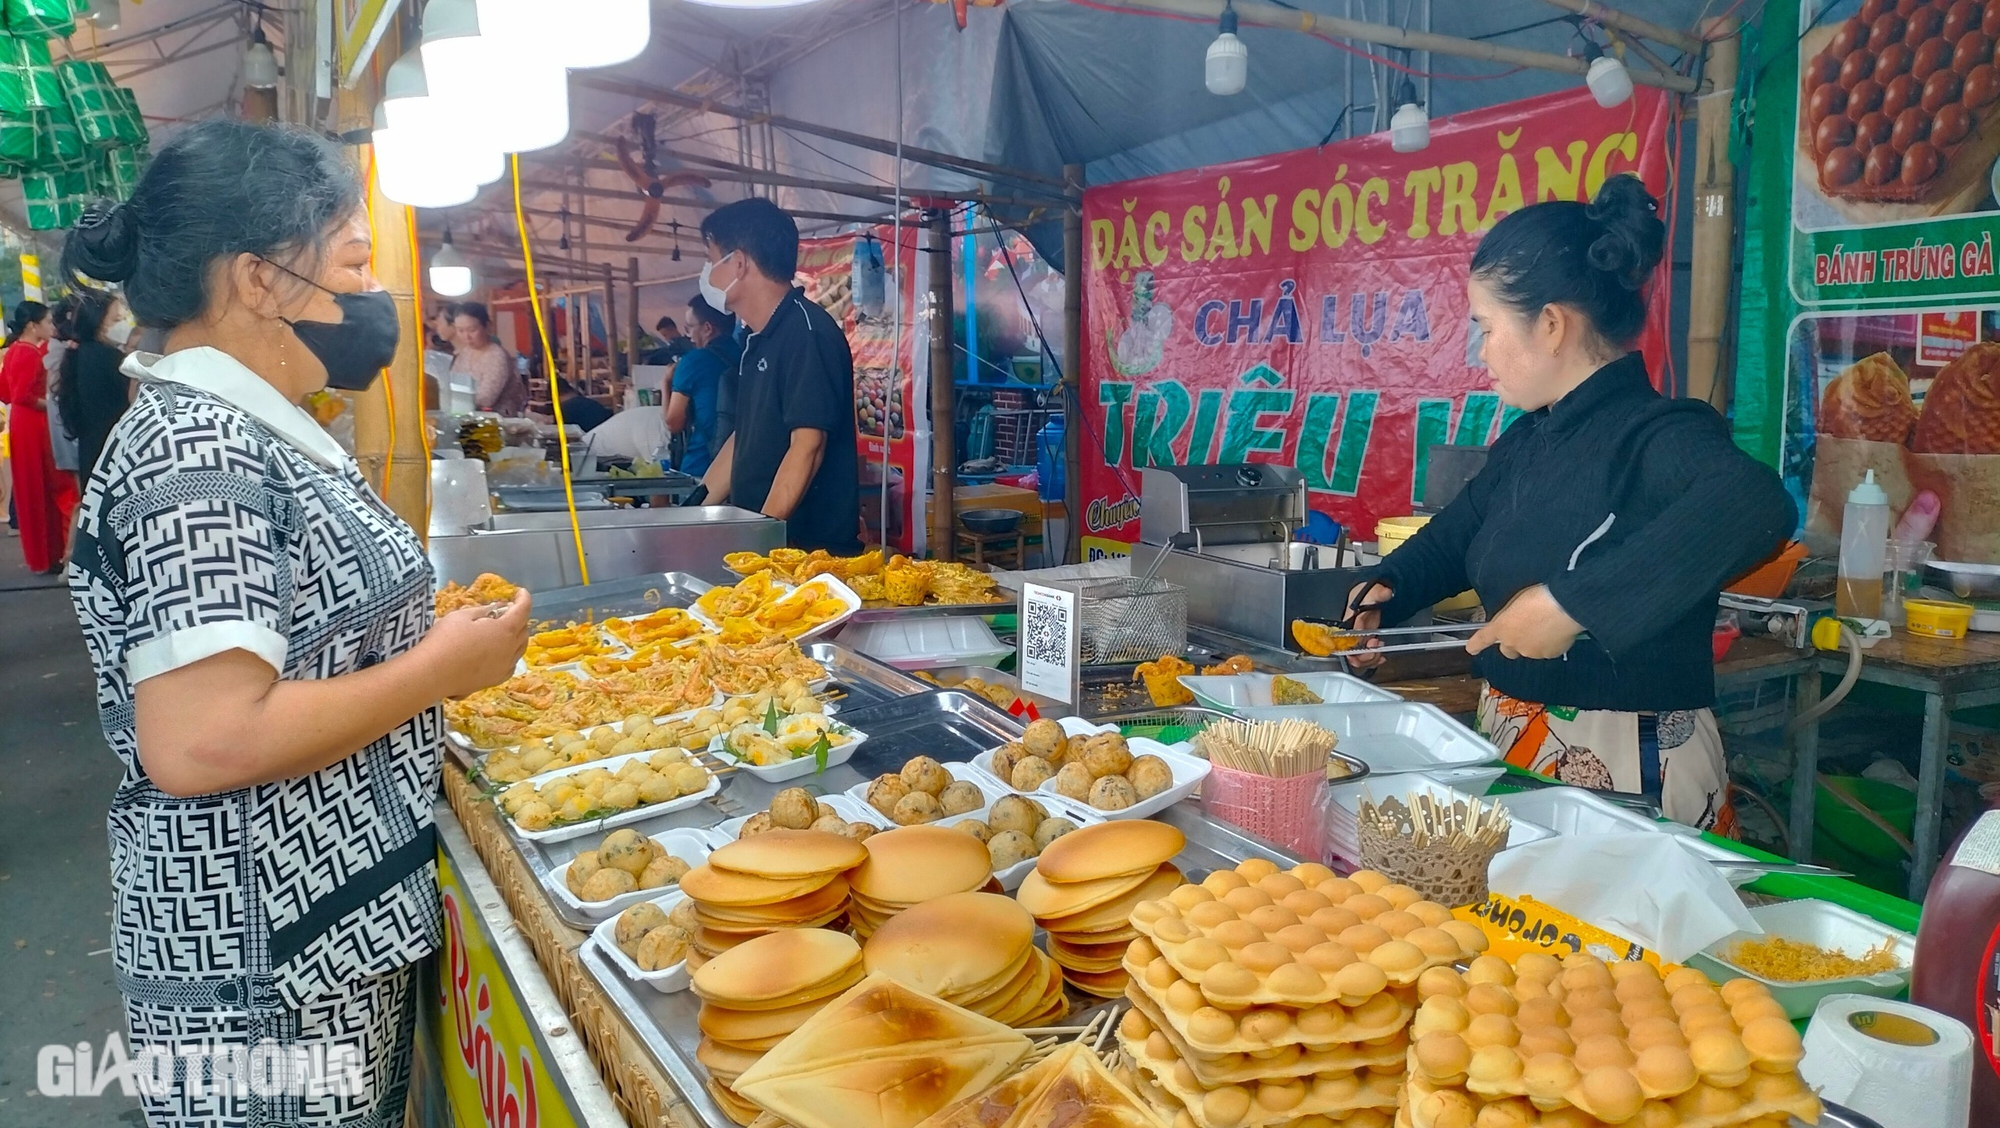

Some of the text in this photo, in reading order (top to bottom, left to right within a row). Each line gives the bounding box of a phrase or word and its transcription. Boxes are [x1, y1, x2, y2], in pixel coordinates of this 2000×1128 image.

[1089, 196, 1170, 284] ĐẶC
[1181, 176, 1278, 262] SẢN
[1289, 163, 1390, 252] SÓC
[1815, 231, 1994, 286] BÁNH TRỨNG GÀ
[1194, 279, 1432, 359] CHẢ LỤA
